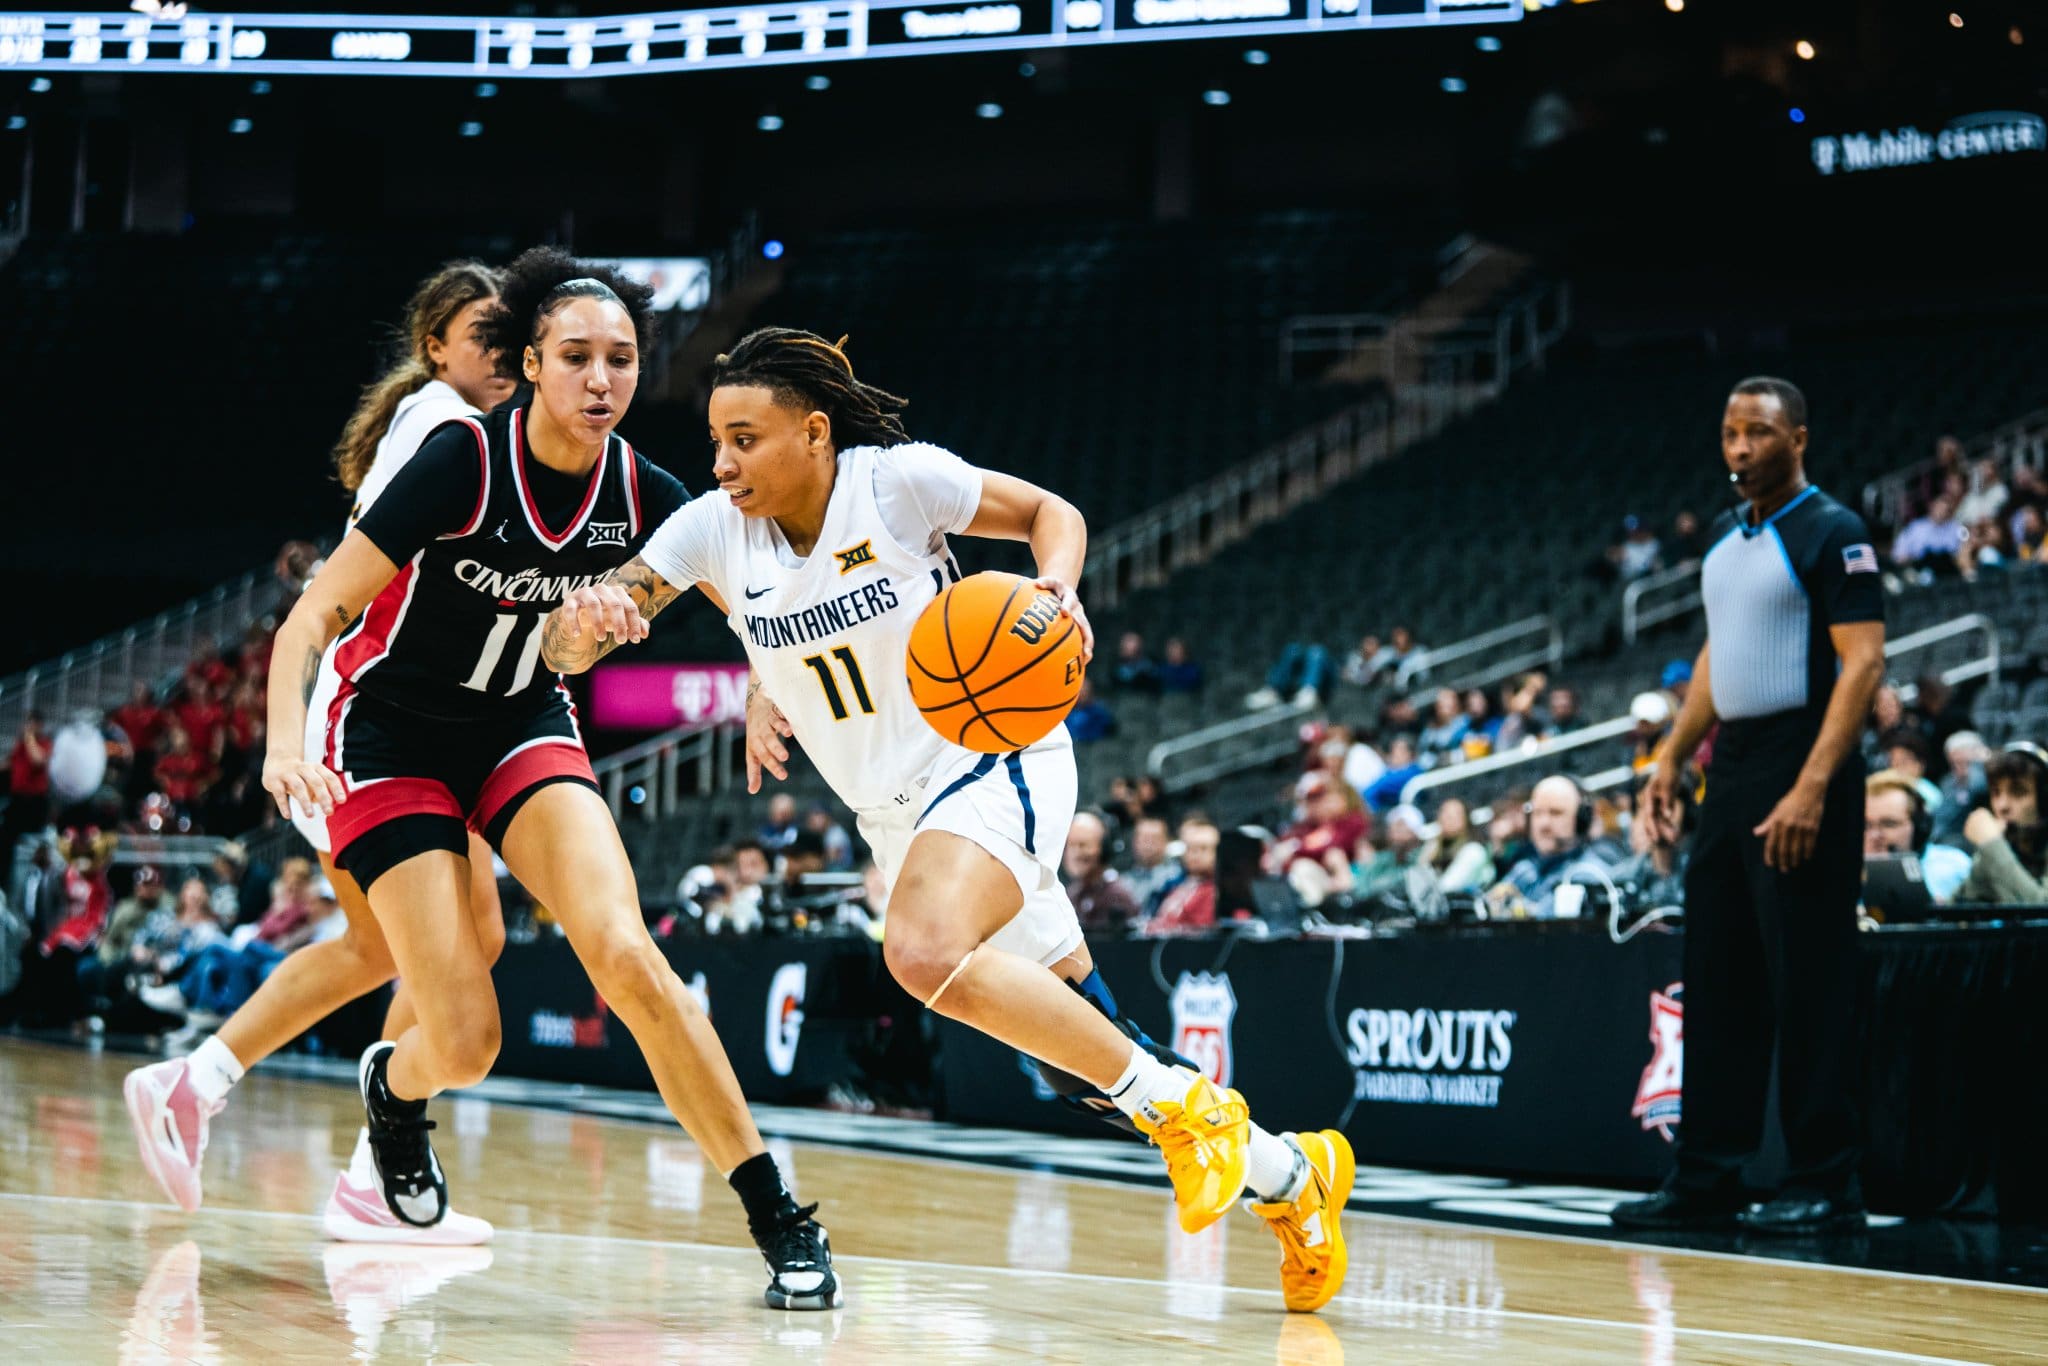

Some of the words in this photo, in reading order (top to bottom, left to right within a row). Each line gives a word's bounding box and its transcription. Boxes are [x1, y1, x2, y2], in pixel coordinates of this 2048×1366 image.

[1842, 127, 1936, 172] Mobile
[745, 577, 899, 648] MOUNTAINEERS
[459, 613, 550, 697] 11
[803, 645, 876, 721] 11
[1347, 1007, 1513, 1071] SPROUTS
